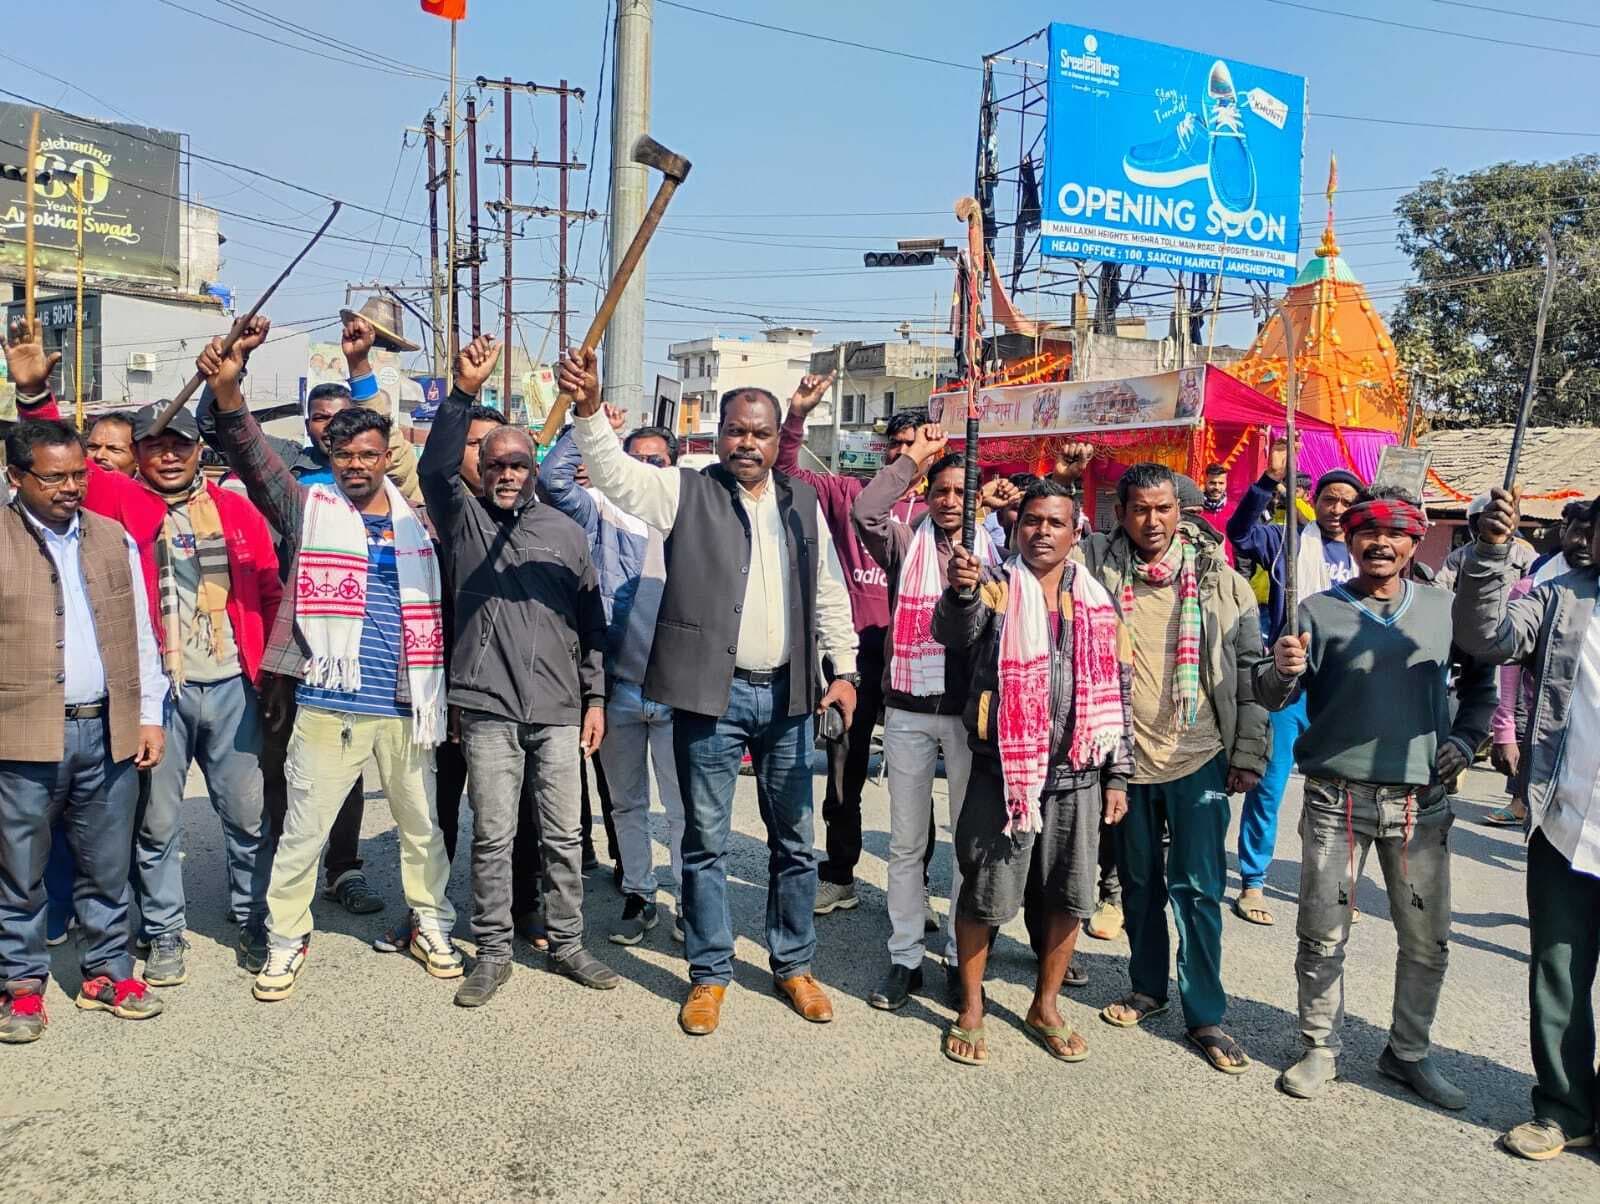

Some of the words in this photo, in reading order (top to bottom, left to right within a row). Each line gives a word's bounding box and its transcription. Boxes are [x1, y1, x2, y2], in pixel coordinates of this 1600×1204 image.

[36, 137, 112, 167] elebrating
[84, 217, 132, 236] Swad
[1057, 182, 1196, 233] OPENING
[1205, 202, 1286, 245] SOON
[1052, 223, 1073, 234] MANI
[1073, 226, 1097, 237] LAXMI
[1131, 233, 1159, 245] MISHRA
[1051, 240, 1080, 253] HEAD
[1082, 243, 1116, 258] OFFICE
[1147, 251, 1183, 266] SAKCHI
[1225, 260, 1286, 279] JAMSHEDPUR
